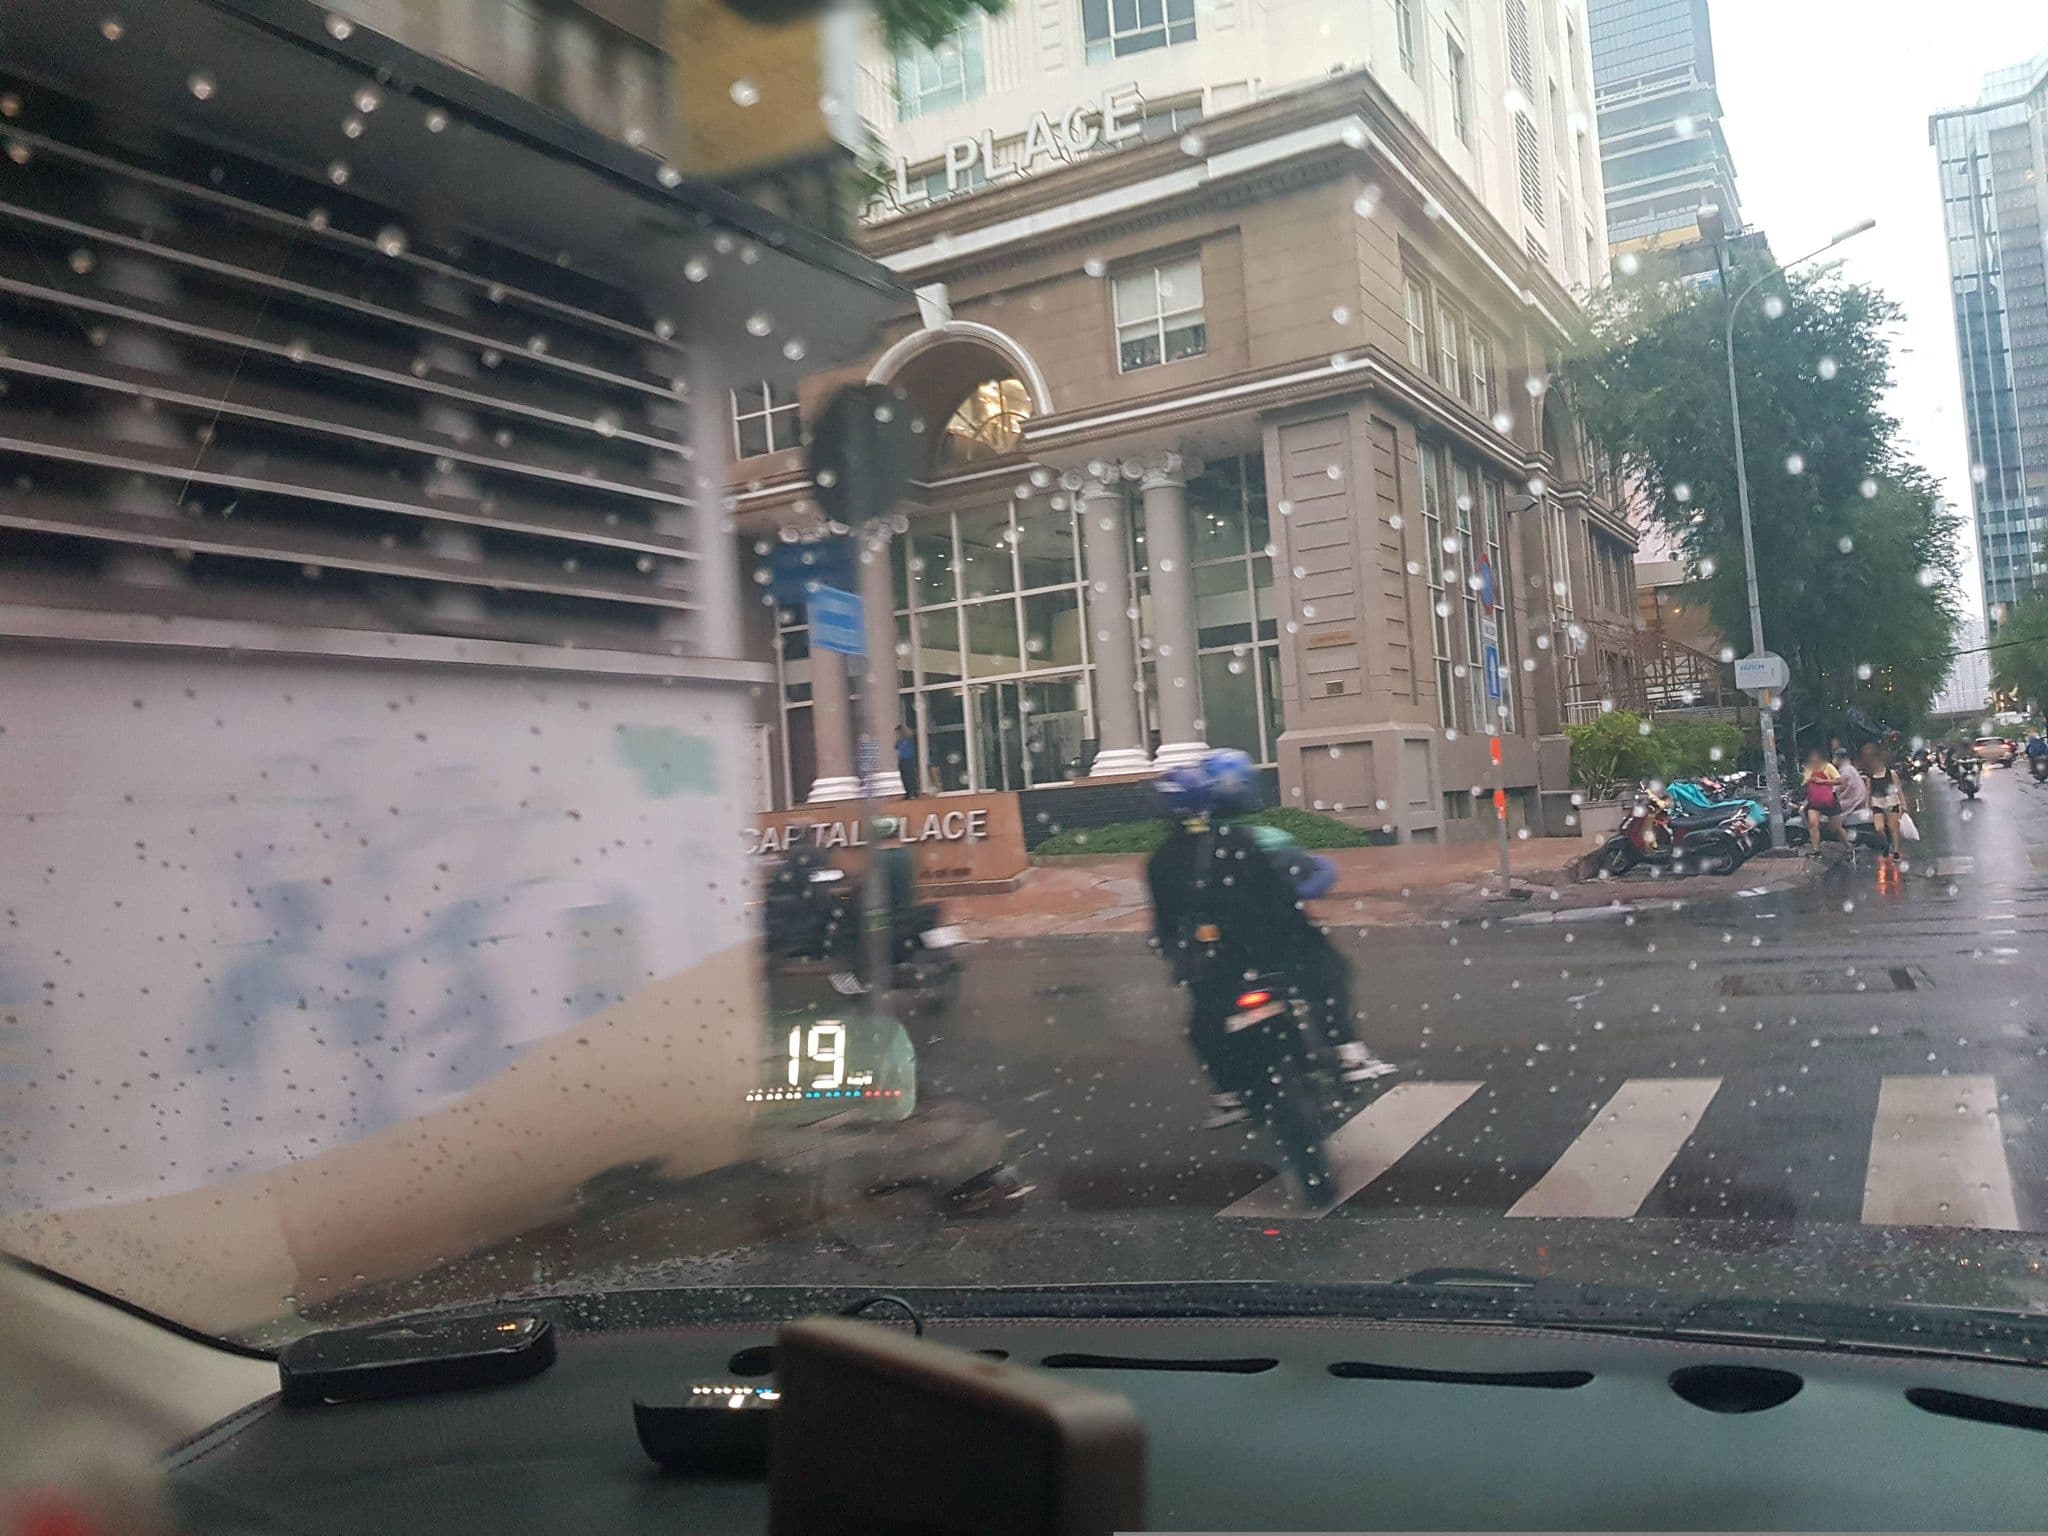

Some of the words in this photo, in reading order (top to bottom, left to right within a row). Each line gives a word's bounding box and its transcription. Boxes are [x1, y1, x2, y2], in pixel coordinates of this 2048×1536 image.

[944, 80, 1144, 192] PLACE
[741, 820, 869, 854] CAPTAL
[788, 1020, 846, 1089] 19
